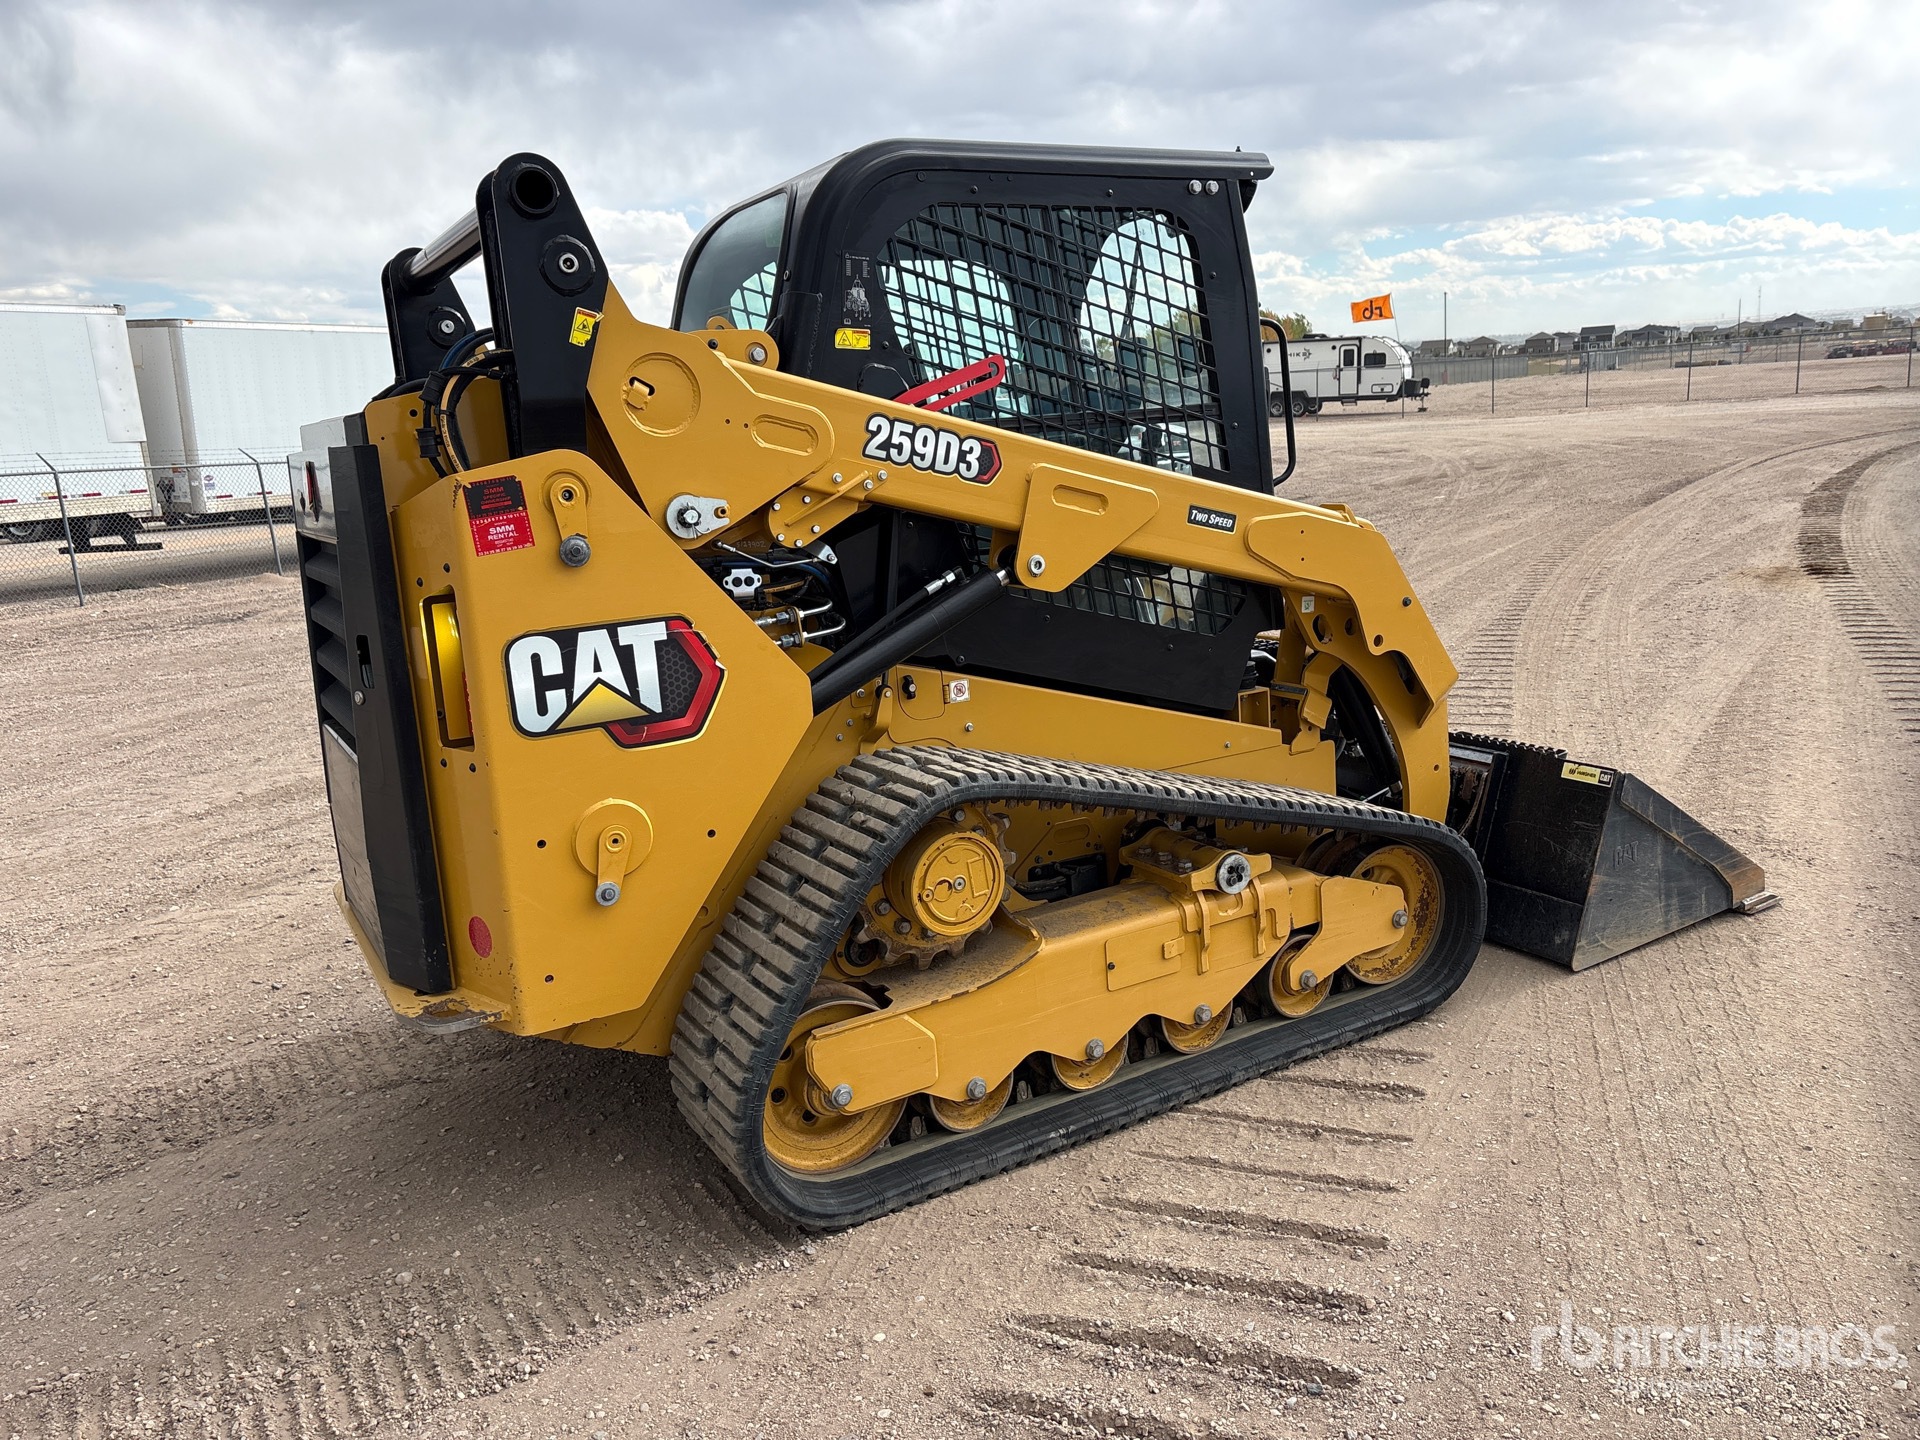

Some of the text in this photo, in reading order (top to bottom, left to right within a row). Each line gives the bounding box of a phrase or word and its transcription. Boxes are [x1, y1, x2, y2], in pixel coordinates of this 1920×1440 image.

[865, 416, 981, 479] 259D3
[489, 524, 515, 535] SMM
[488, 531, 519, 541] RENTAL
[509, 621, 667, 733] CAT
[1600, 773, 1612, 782] CAT
